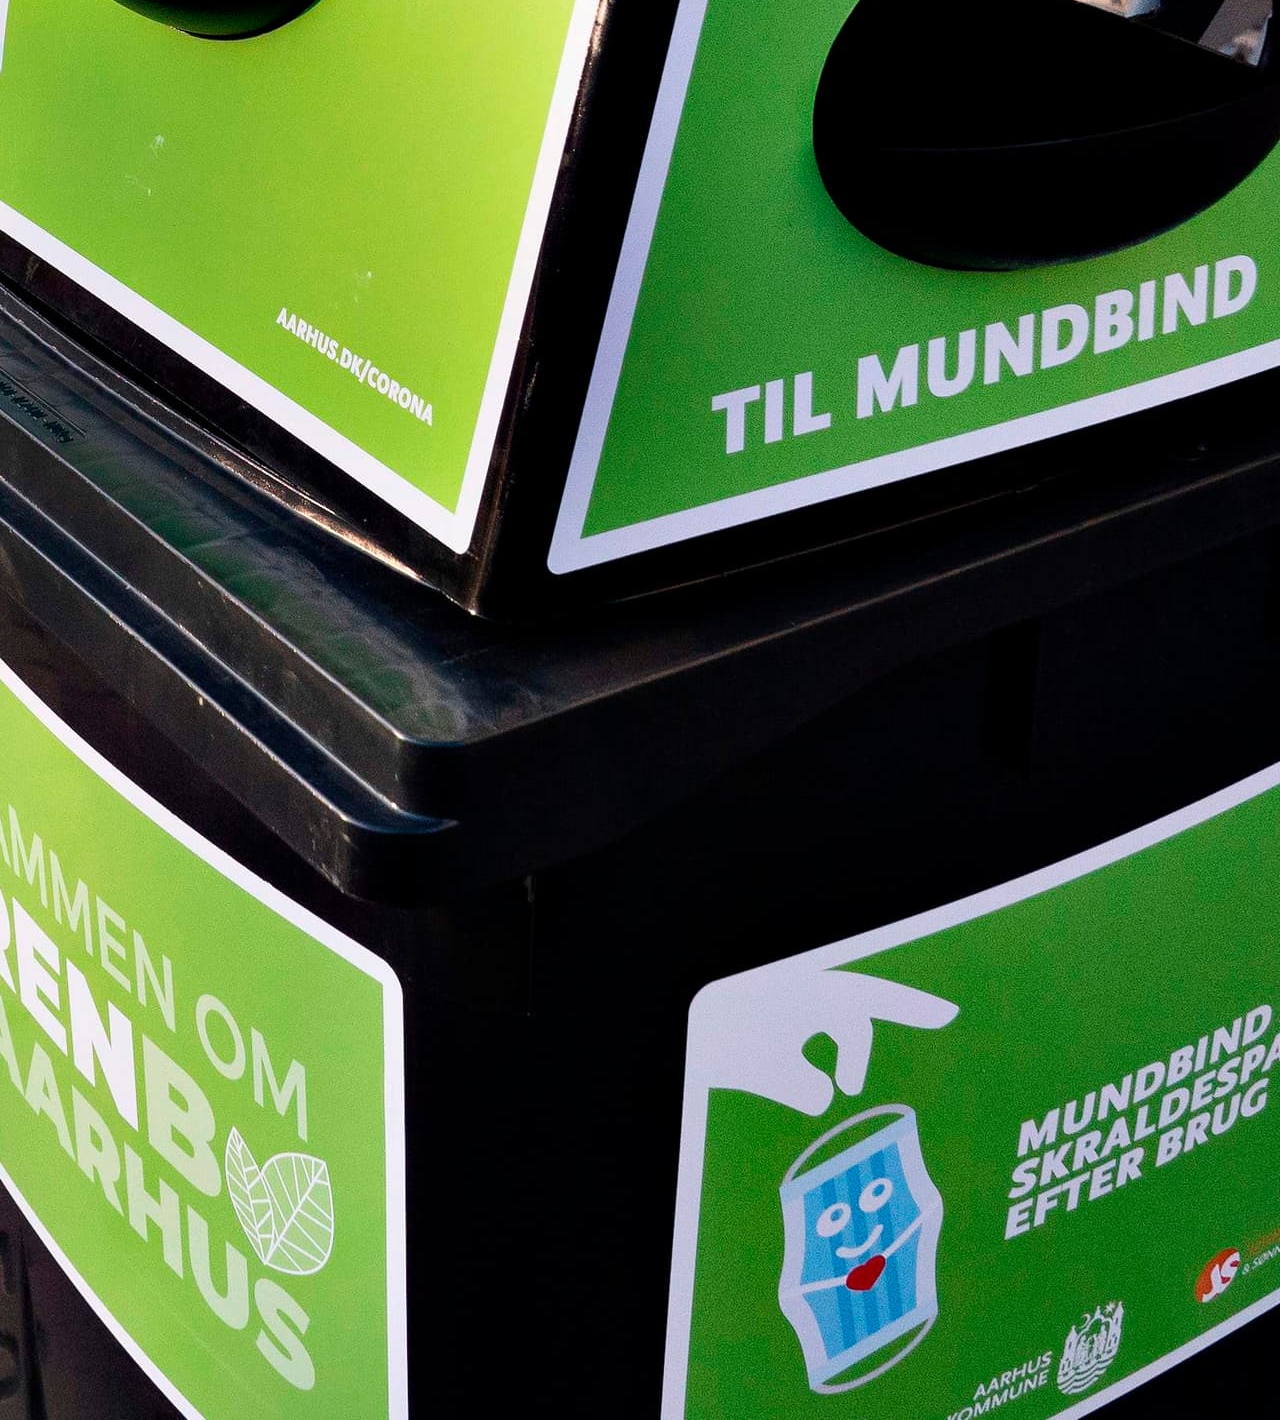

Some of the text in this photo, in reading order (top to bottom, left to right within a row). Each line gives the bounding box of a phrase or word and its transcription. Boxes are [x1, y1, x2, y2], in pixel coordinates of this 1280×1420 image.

[276, 307, 433, 427] AARHUS.DK/CORONA
[711, 254, 1258, 454] TIL MUNDBIND
[195, 993, 308, 1143] OM
[1017, 1004, 1272, 1157] MUNDBIND
[1004, 1078, 1269, 1240] EFTER BRUG
[973, 1350, 1053, 1401] AARHUS
